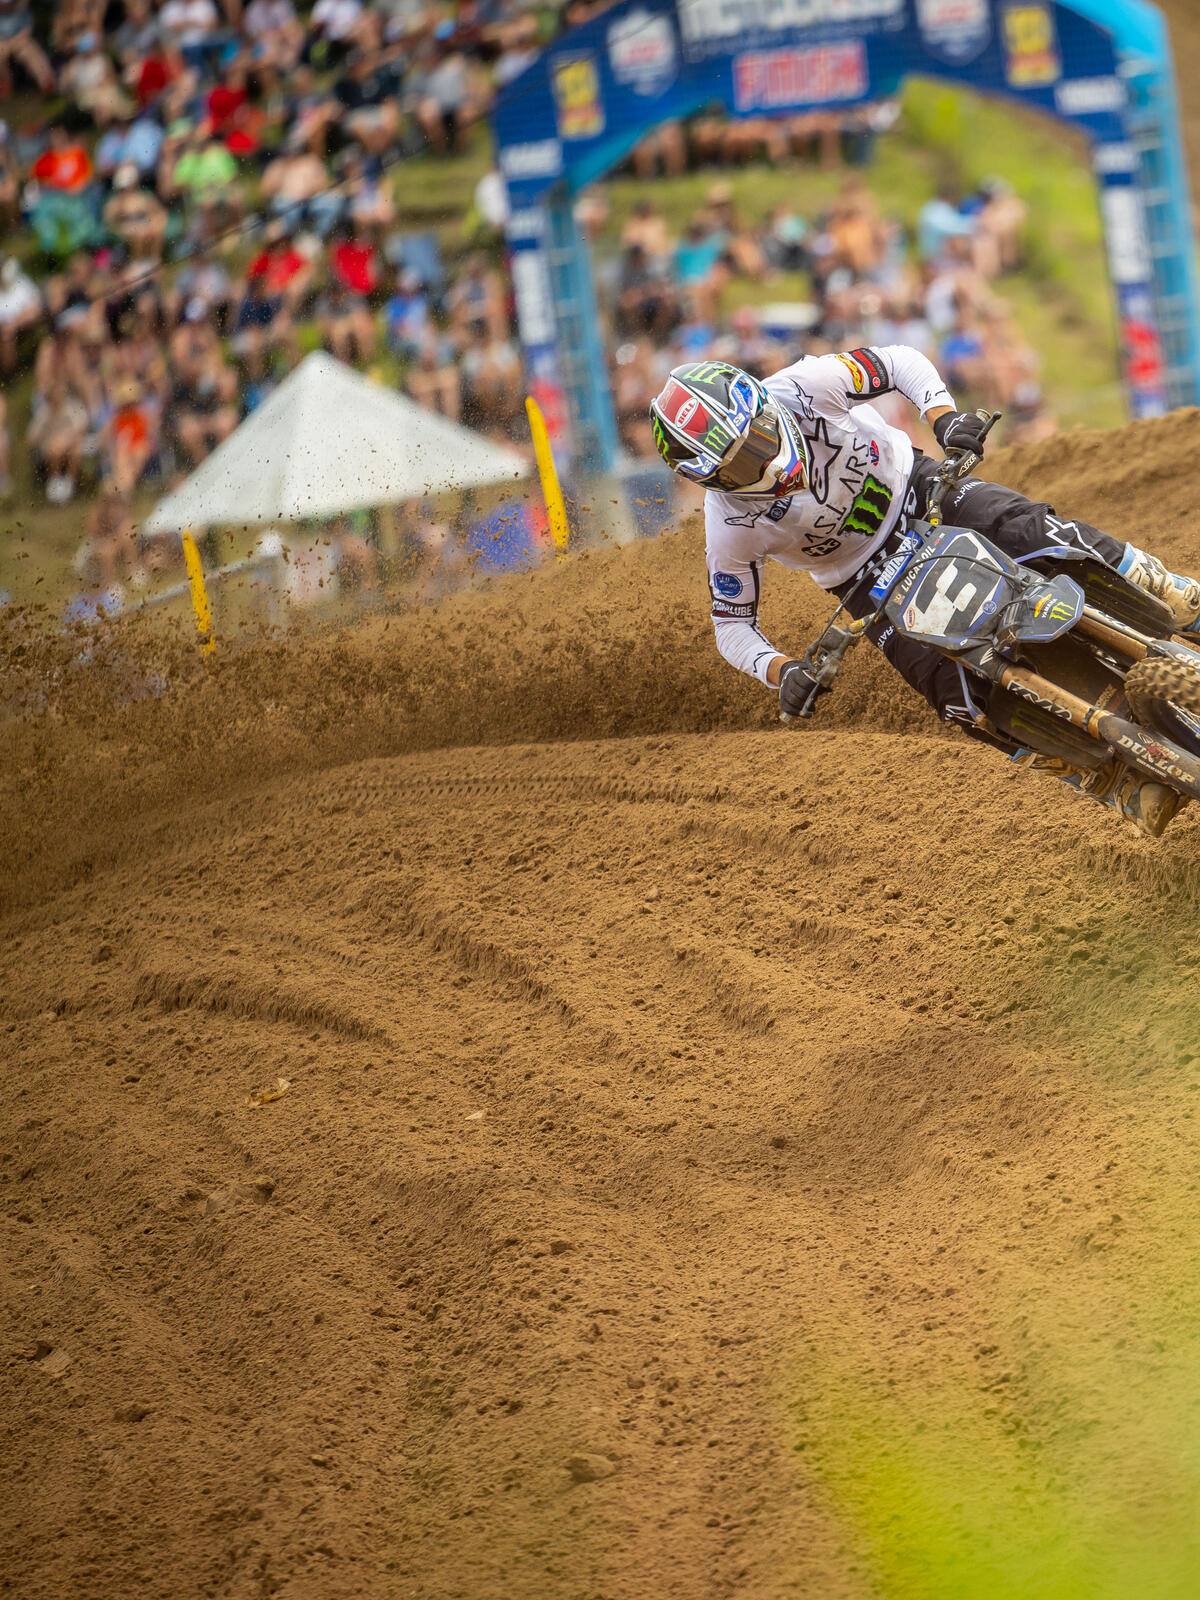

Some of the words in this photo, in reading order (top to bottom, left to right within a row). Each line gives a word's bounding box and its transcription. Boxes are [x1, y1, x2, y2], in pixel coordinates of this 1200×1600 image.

[677, 401, 696, 425] BELL
[921, 545, 936, 560] OIL
[916, 536, 1002, 635] 3
[1117, 735, 1196, 783] DUNLOP
